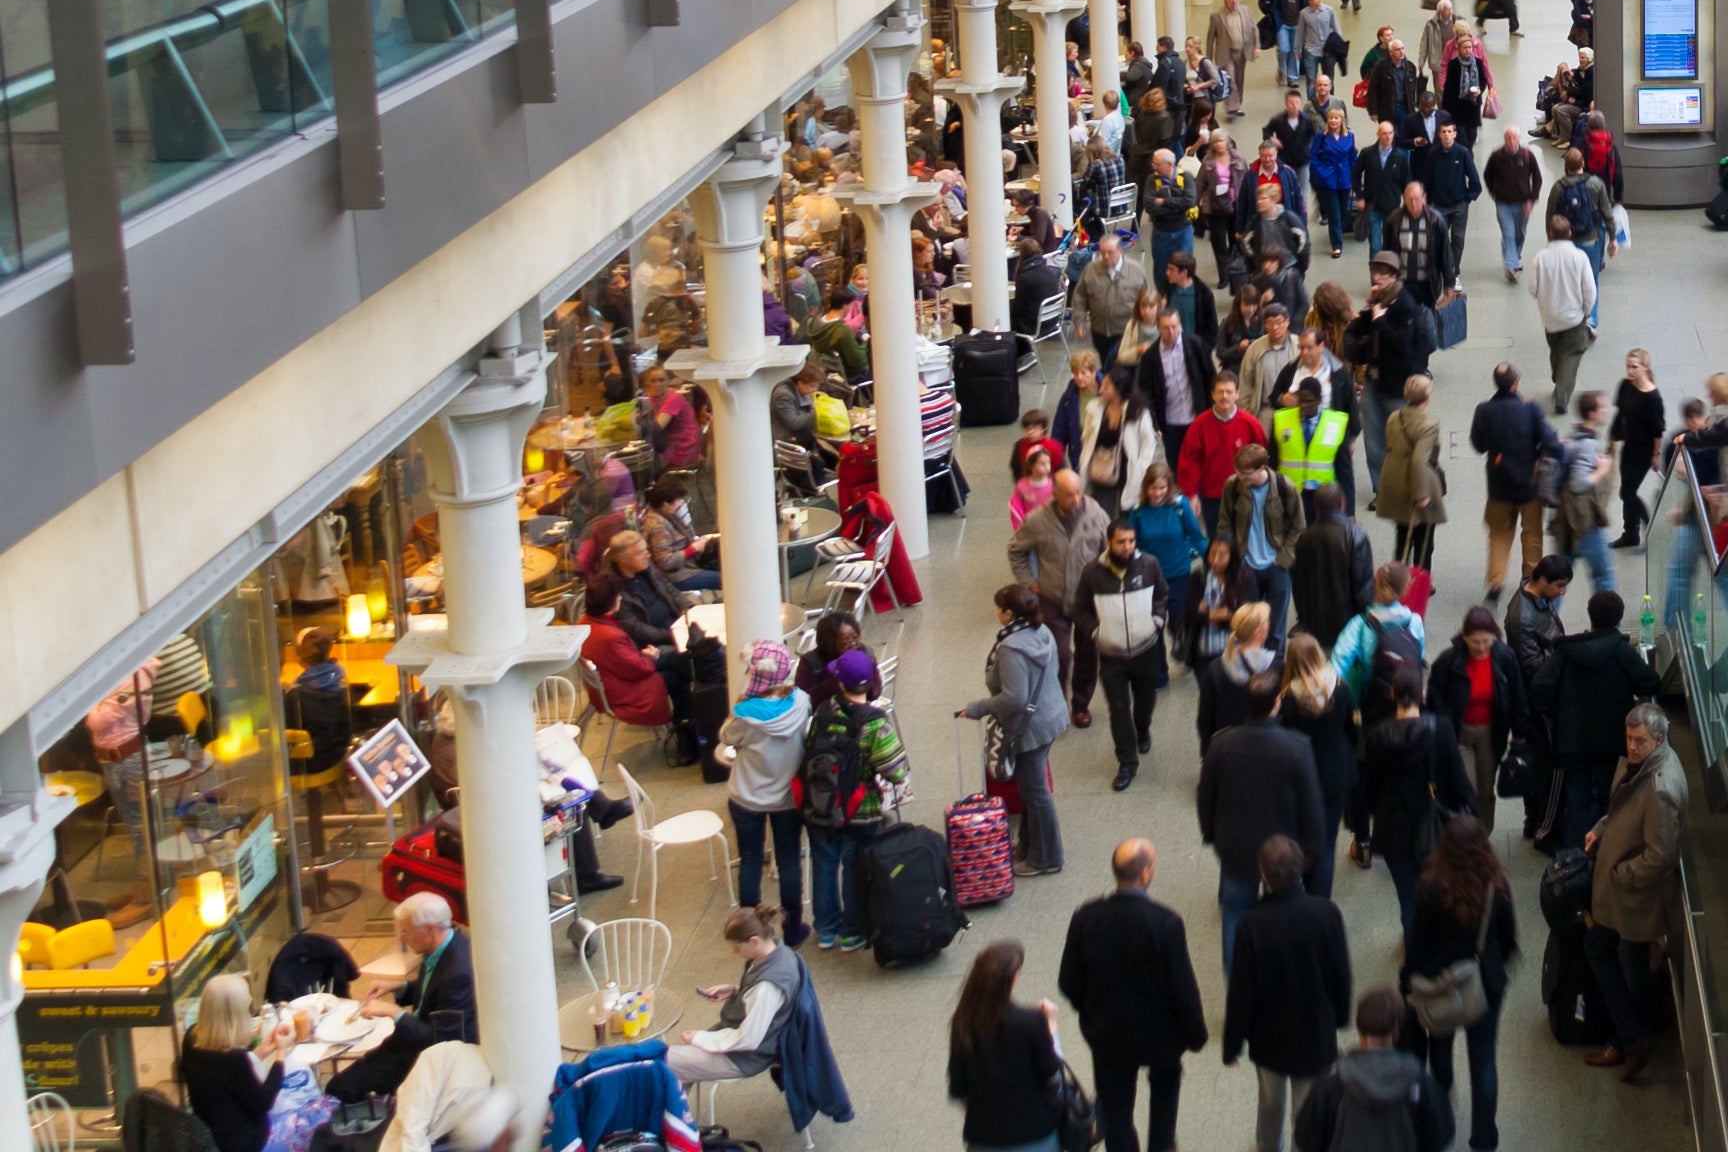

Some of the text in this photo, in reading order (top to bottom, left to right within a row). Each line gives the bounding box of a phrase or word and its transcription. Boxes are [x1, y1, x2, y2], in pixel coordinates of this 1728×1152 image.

[38, 1005, 161, 1017] sweet & savoury
